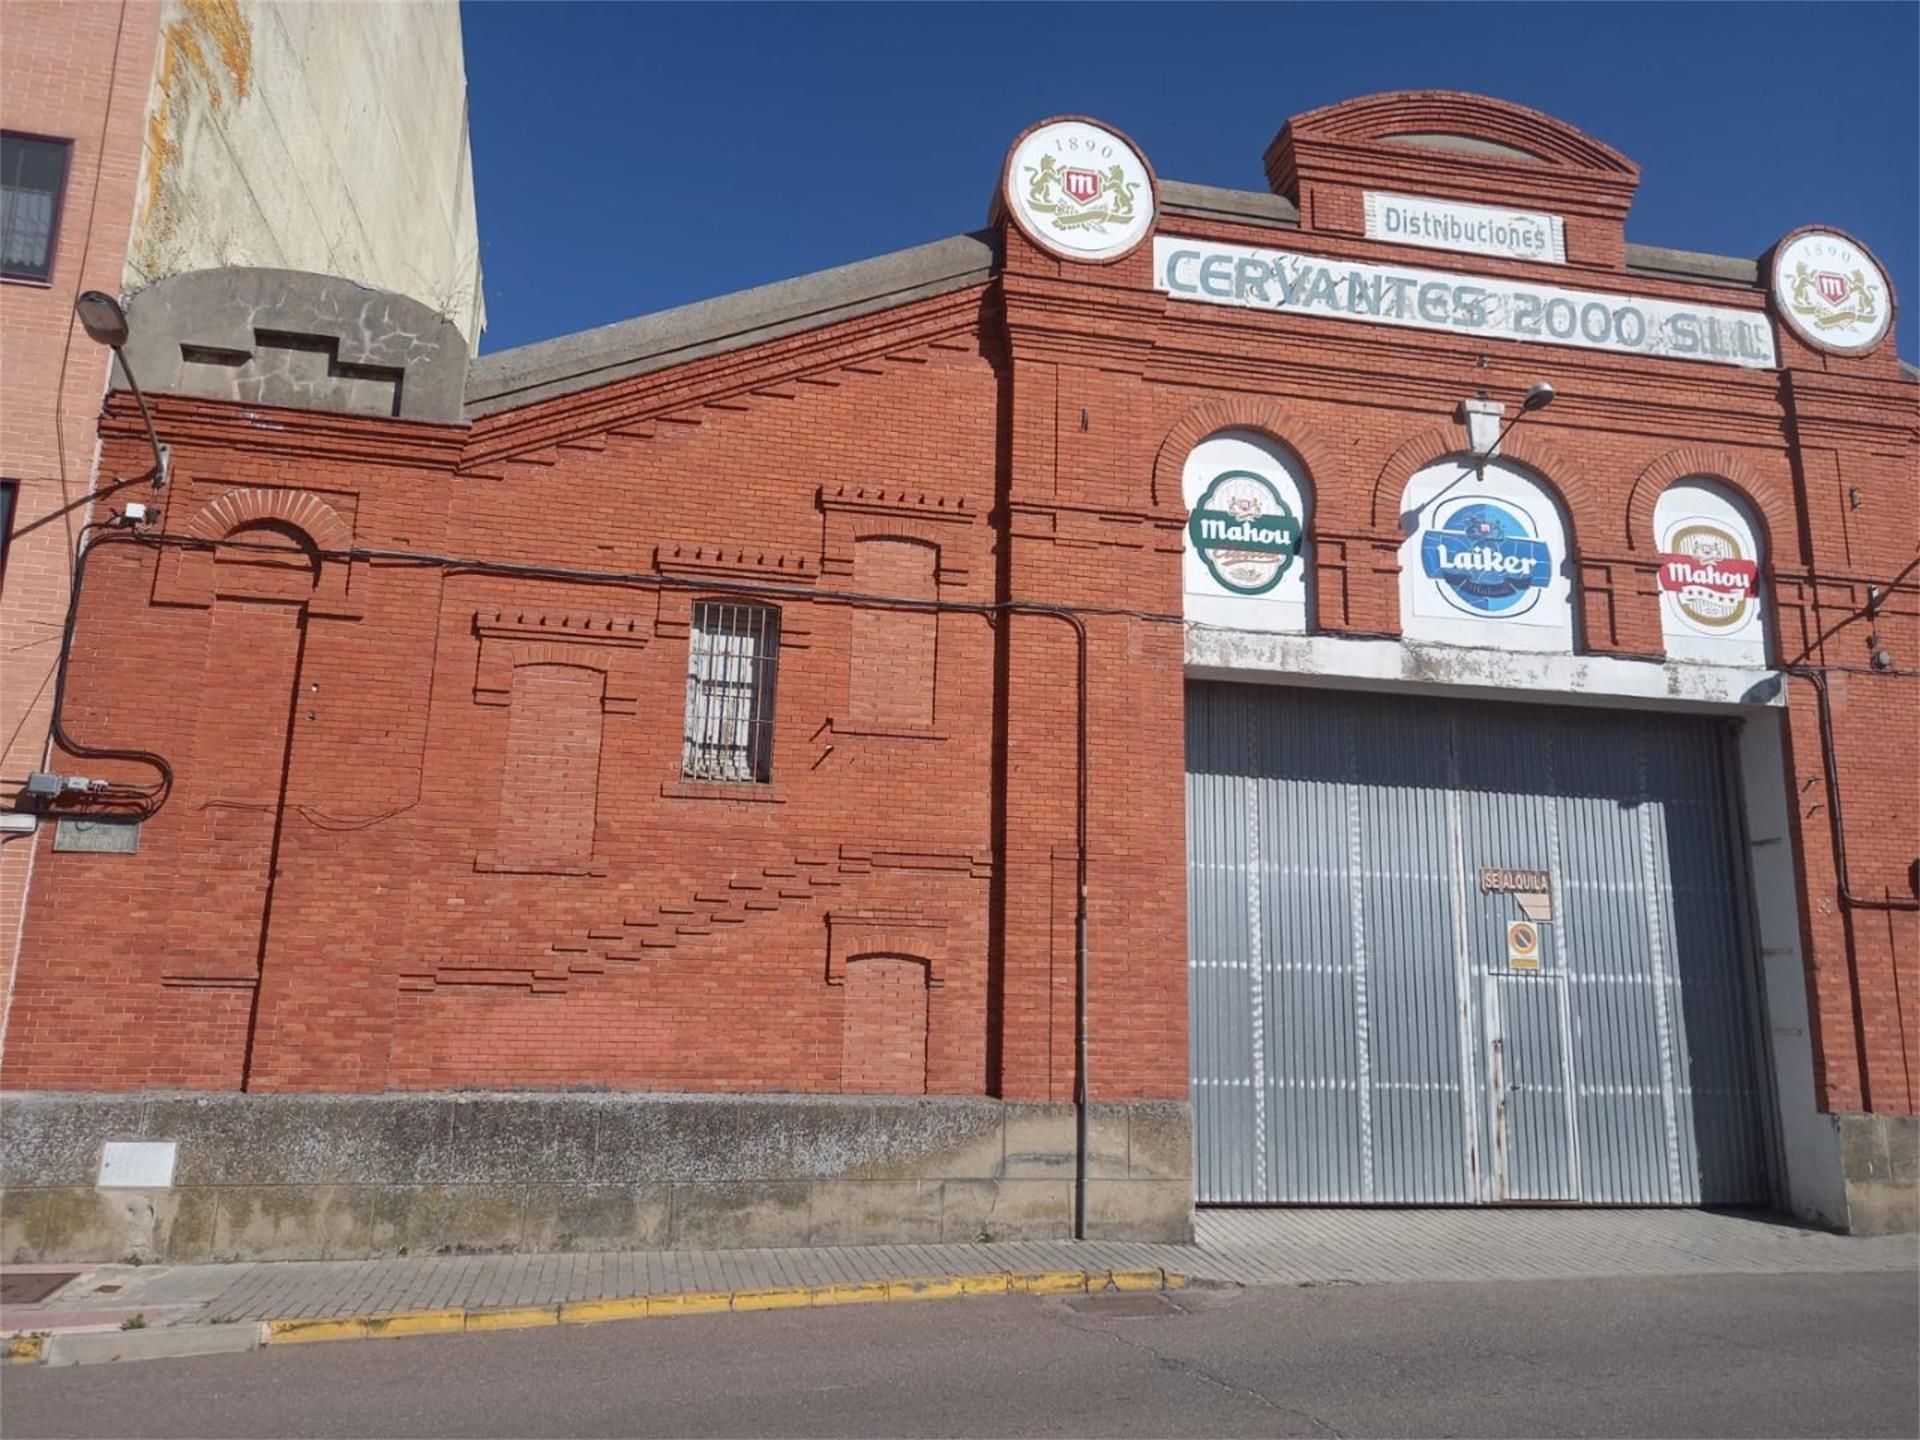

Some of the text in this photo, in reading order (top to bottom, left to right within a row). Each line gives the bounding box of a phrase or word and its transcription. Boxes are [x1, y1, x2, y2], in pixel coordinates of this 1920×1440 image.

[1055, 137, 1113, 159] 1890
[1385, 207, 1545, 250] Distribuciones
[1804, 243, 1850, 262] 1890
[1166, 250, 1486, 327] CERVANTES
[1513, 292, 1646, 347] 2000
[1201, 518, 1292, 546] Mahou
[1437, 543, 1537, 575] Laiker
[1668, 562, 1750, 588] Mahou
[1486, 872, 1548, 890] SE ALQUILA
